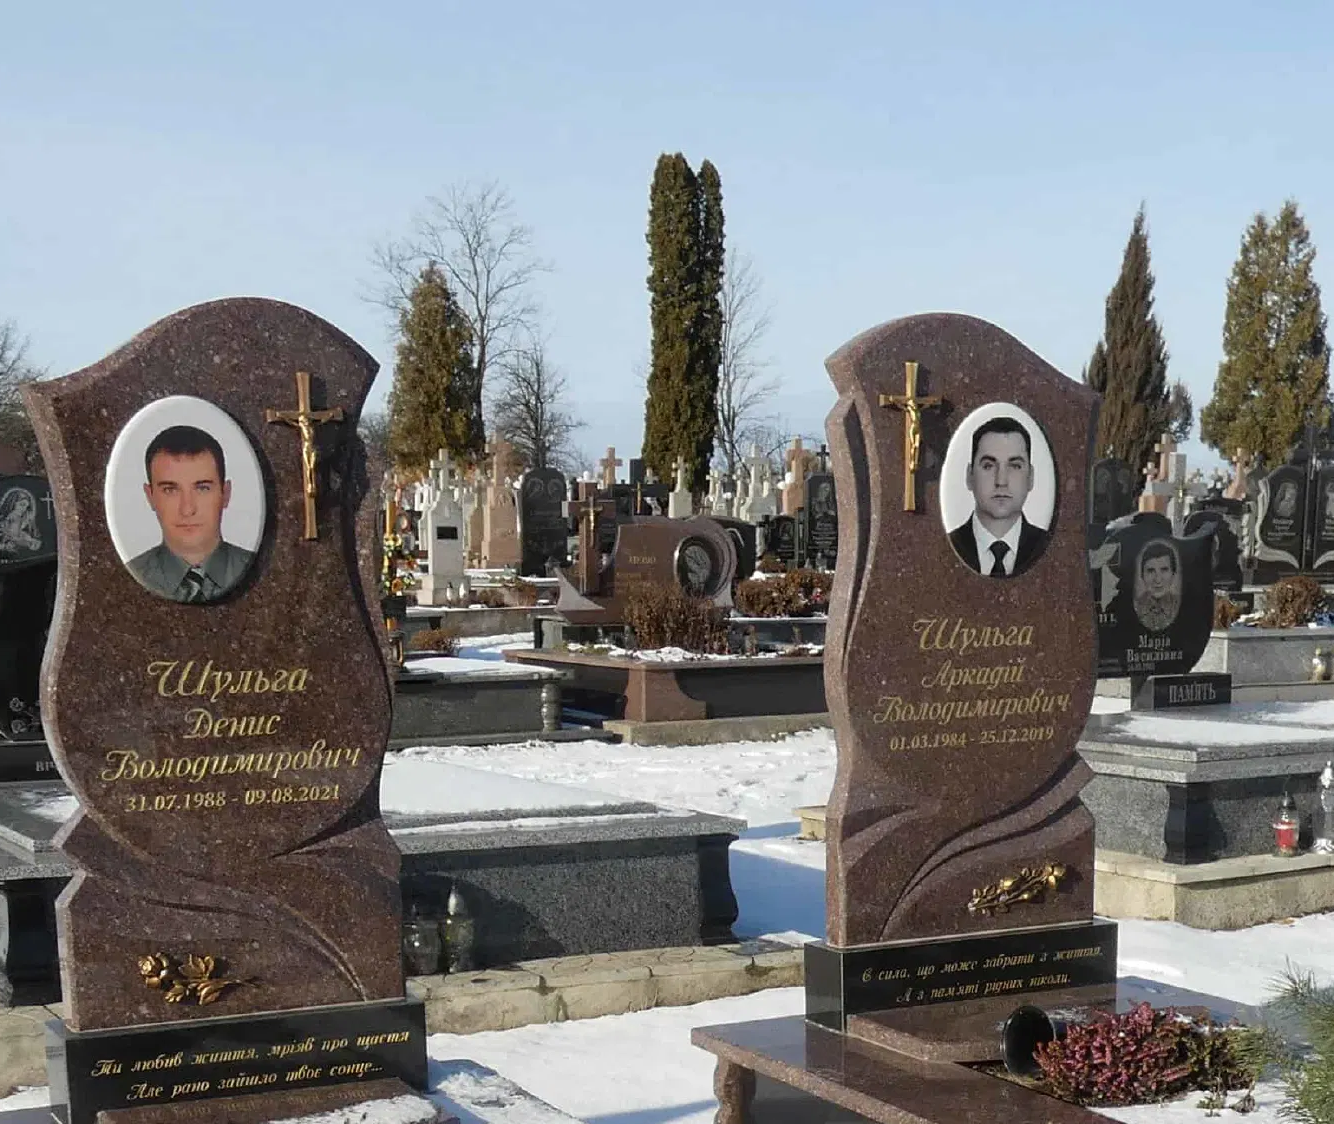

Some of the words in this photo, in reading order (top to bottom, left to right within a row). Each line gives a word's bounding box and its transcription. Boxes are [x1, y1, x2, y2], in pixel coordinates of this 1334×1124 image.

[913, 616, 1034, 655] Шульга
[147, 660, 309, 702] Шульга
[921, 657, 1027, 693] Аркадій
[183, 708, 281, 738] Денис
[873, 687, 1072, 725] Володимирович
[889, 731, 966, 751] 01.03.1984
[980, 726, 1054, 746] 25.12.2019
[100, 740, 361, 783] Володимирович
[124, 791, 226, 812] 31.07.1988
[245, 784, 339, 805] 09.08.2021
[916, 965, 936, 980] що
[940, 960, 978, 973] може
[982, 953, 1035, 970] забрати
[983, 978, 1023, 995] рідних
[91, 1059, 123, 1077] Ти
[131, 1051, 184, 1072] любив
[267, 1036, 315, 1059] мріяв
[322, 1038, 348, 1053] про
[356, 1031, 409, 1051] щастя
[126, 1081, 164, 1100] Але
[170, 1080, 210, 1098] рано
[217, 1071, 277, 1090] зайшло
[285, 1064, 323, 1082] твоє
[329, 1061, 383, 1078] сонце...
